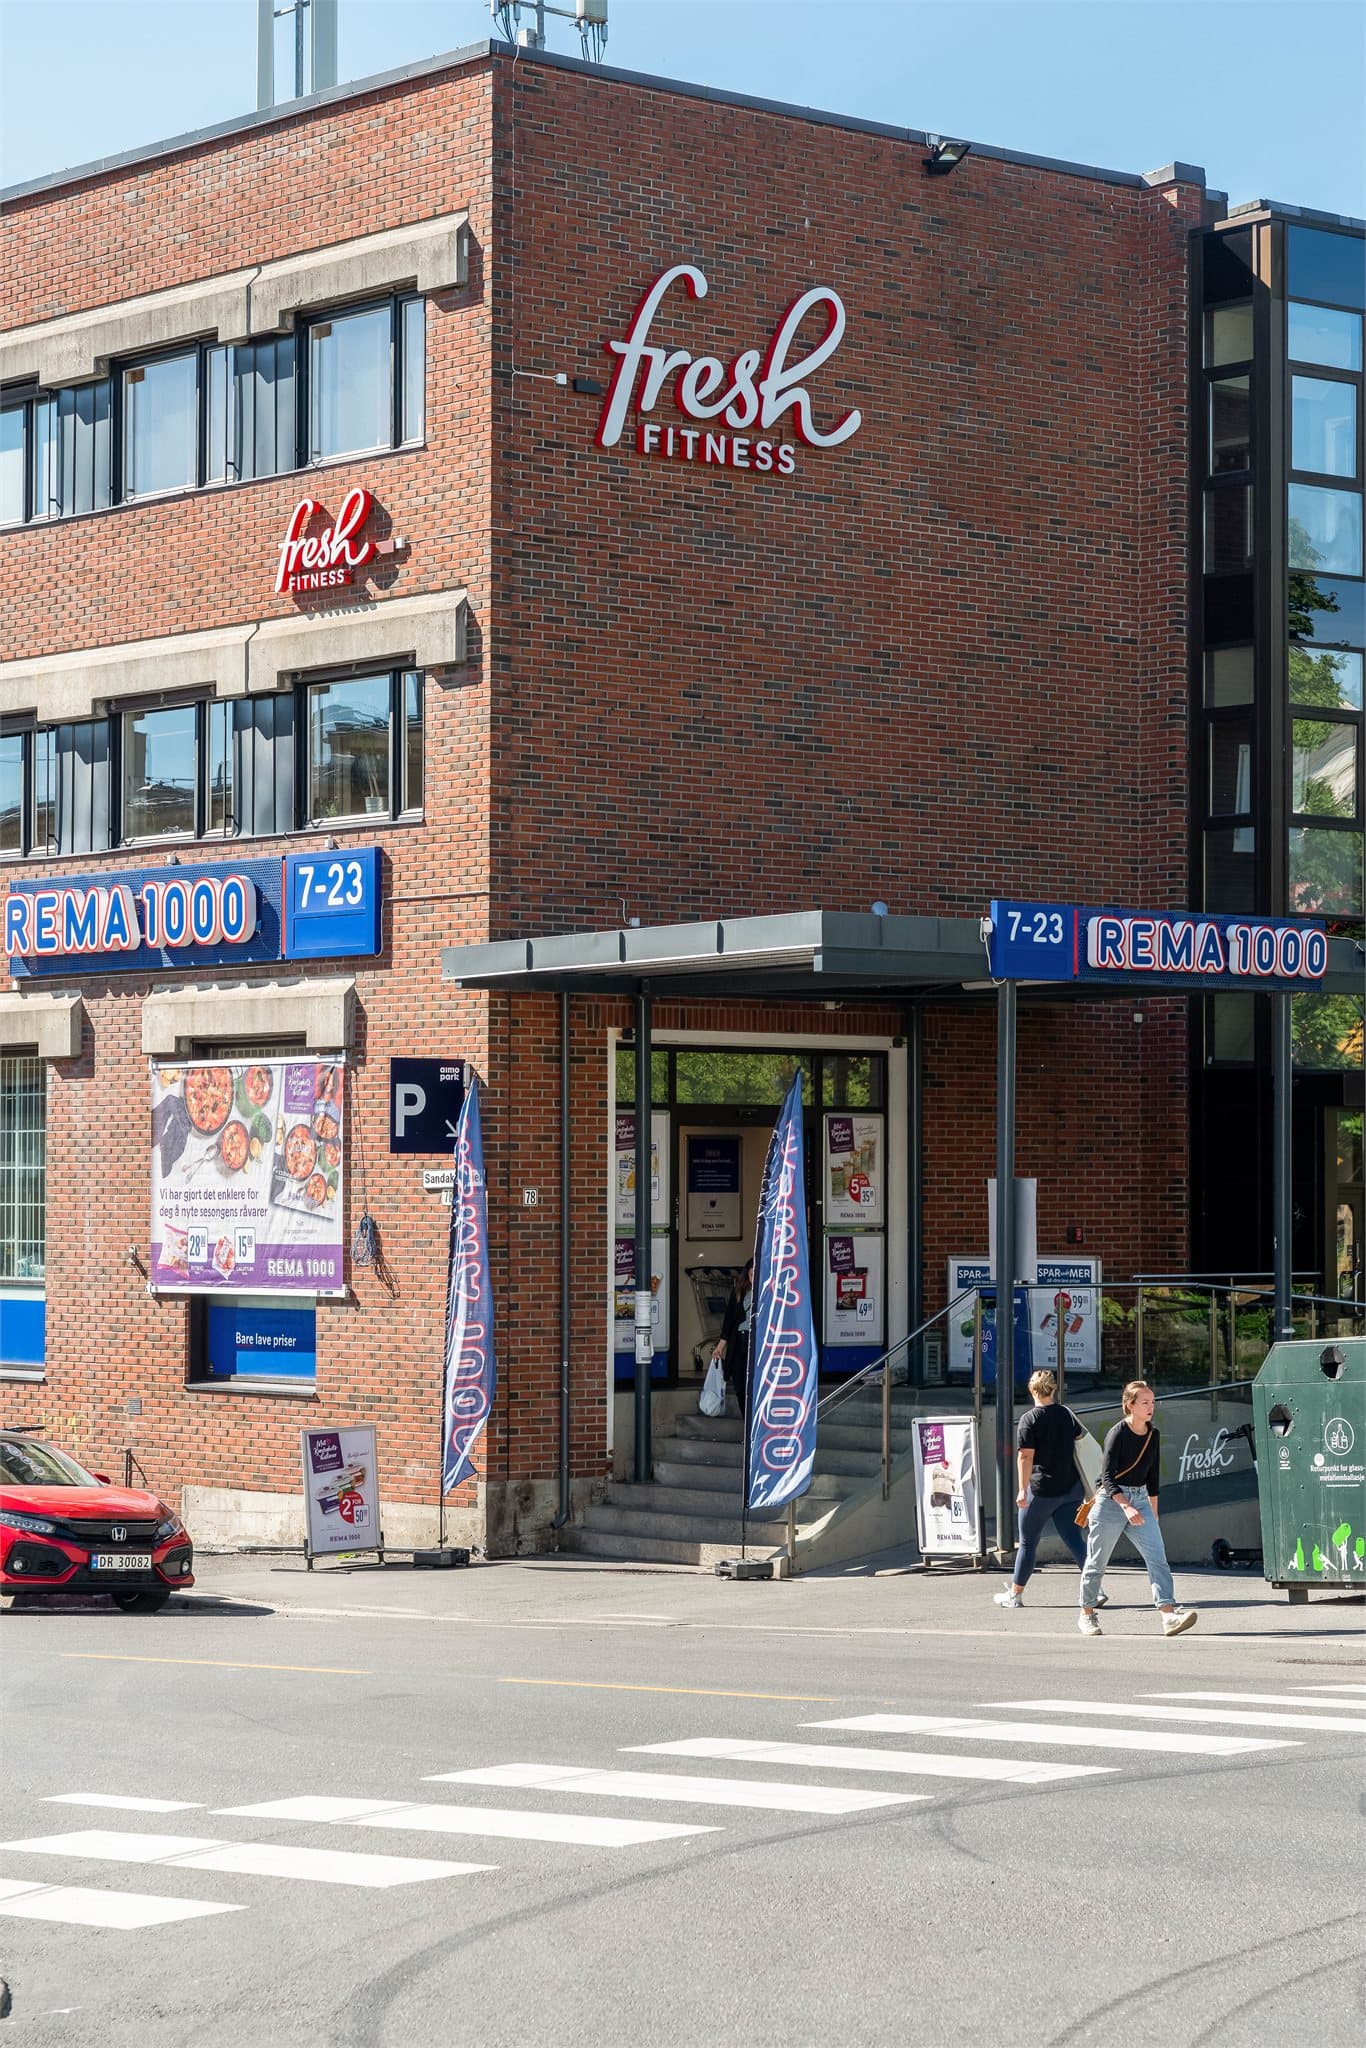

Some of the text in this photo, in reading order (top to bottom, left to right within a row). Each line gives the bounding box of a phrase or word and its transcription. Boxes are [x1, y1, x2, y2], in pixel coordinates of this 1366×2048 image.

[602, 265, 862, 447] fresh
[642, 424, 796, 474] FITNESS
[275, 488, 369, 592] fresh
[289, 569, 345, 592] FITNESS
[298, 861, 364, 908] 7-23
[5, 874, 248, 957] REMA 1000
[1008, 911, 1064, 944] 7-23
[1096, 915, 1328, 979] REMA 1000
[439, 1066, 460, 1074] aimo
[439, 1073, 460, 1082] park
[395, 1083, 427, 1137] P
[850, 1178, 860, 1194] 5
[159, 1188, 259, 1203] Vi har gjort det enklere for
[525, 1190, 536, 1204] 78
[861, 1190, 870, 1203] 35
[159, 1205, 268, 1220] deg å nyte sesongens råvarer
[189, 1235, 201, 1257] 28
[238, 1235, 247, 1257] 15
[267, 1258, 304, 1277] REMA
[306, 1257, 336, 1276] 1000
[957, 1269, 982, 1279] SPAR
[1037, 1268, 1061, 1278] SPAR
[1069, 1268, 1091, 1278] MER
[858, 1303, 868, 1317] 49
[1072, 1295, 1083, 1309] 99
[235, 1331, 297, 1348] Bare lave priser
[1179, 1427, 1234, 1482] fresh
[1187, 1468, 1221, 1481] FITNESS
[342, 1498, 352, 1516] 2
[355, 1509, 364, 1523] 50
[99, 1556, 149, 1568] DR 30082
